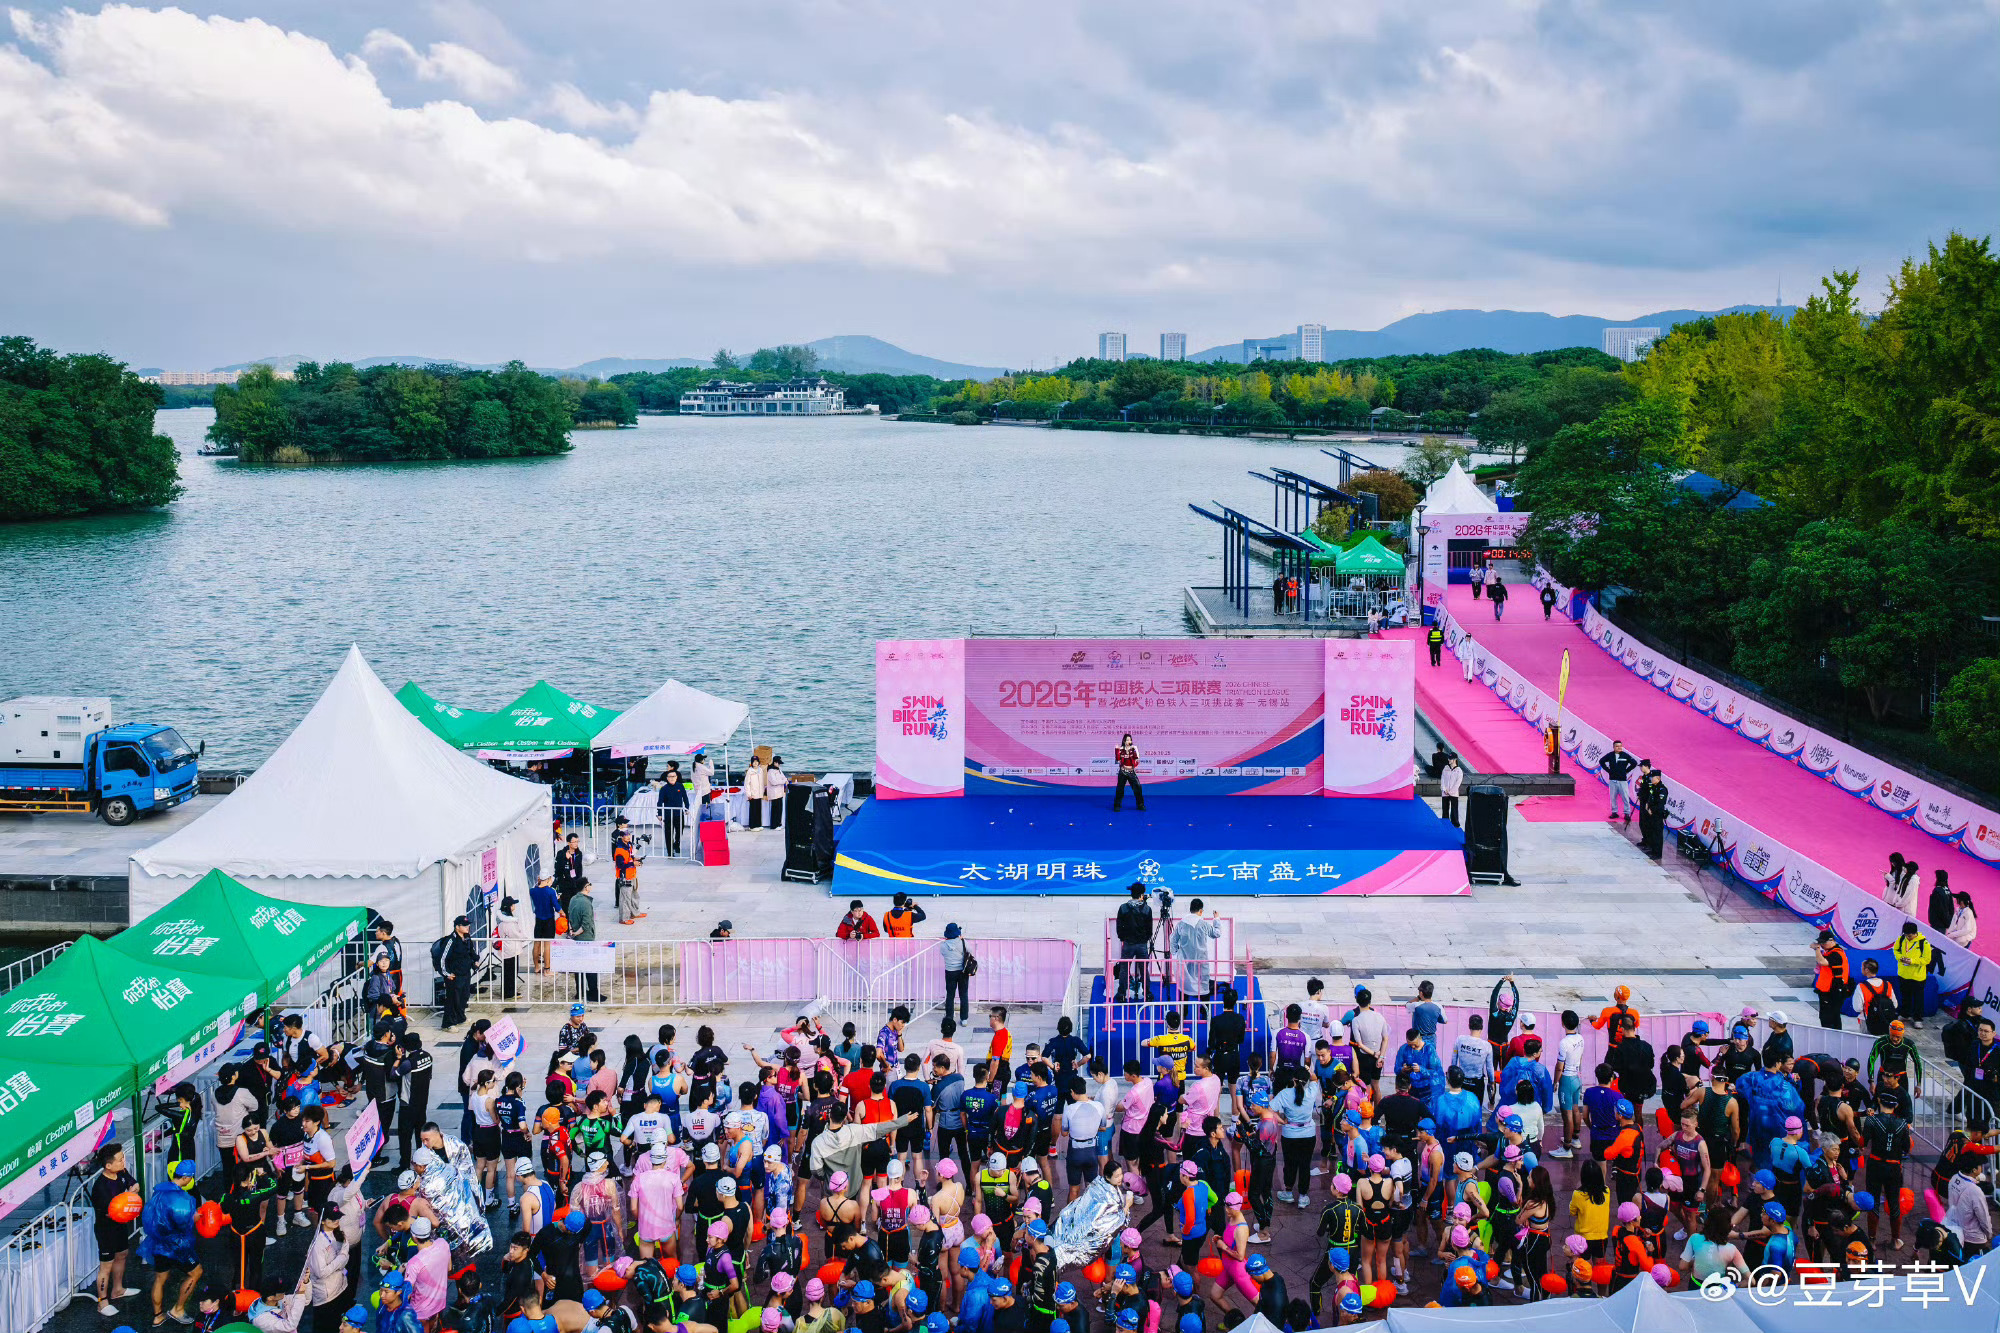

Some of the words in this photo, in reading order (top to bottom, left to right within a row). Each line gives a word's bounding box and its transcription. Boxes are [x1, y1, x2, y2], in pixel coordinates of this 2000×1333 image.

[902, 696, 944, 708] SWIM
[999, 680, 1097, 708] 2026年
[1098, 680, 1222, 695] 中国铁人三项联赛
[1350, 695, 1393, 708] SWIM
[892, 709, 927, 722] BIKE
[1340, 708, 1375, 722] BIKE
[902, 723, 937, 736] RUN
[1350, 722, 1385, 736] RUN
[958, 862, 1108, 882] 太湖明珠
[1190, 861, 1342, 883] 江南盛地
[149, 918, 205, 936] 你我的
[249, 905, 281, 930] 你我的
[272, 907, 307, 936] 怡寶
[152, 936, 220, 956] 怡寶
[121, 976, 162, 1005] 你我的
[150, 977, 194, 1011] 怡寶
[4, 993, 69, 1014] 你我的
[6, 1013, 86, 1036] 怡寶
[1163, 1045, 1188, 1053] JUMBO
[1461, 1044, 1482, 1054] NEXT
[496, 1101, 513, 1109] FILA
[639, 1119, 658, 1127] LETO
[39, 1149, 69, 1179] 检录区
